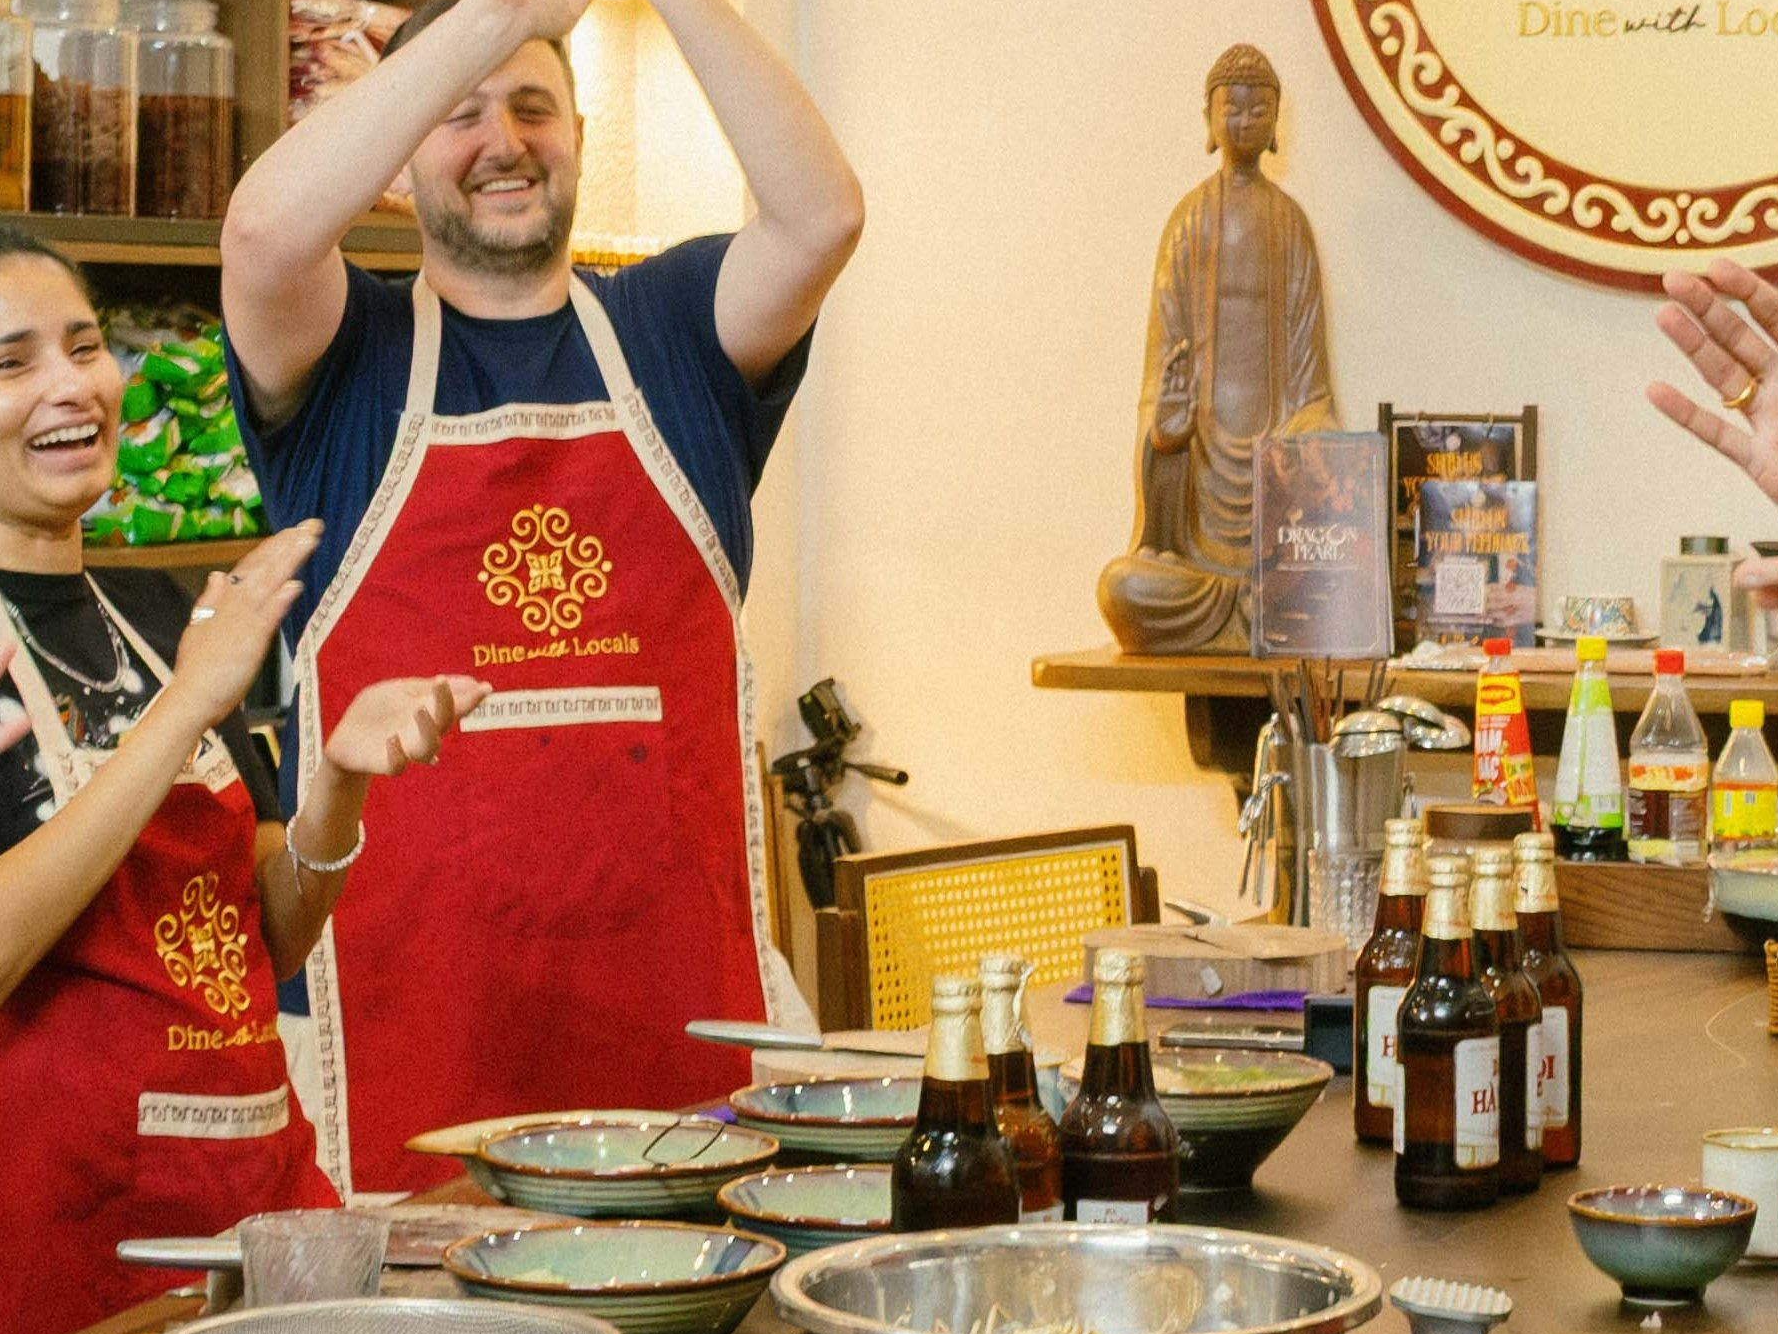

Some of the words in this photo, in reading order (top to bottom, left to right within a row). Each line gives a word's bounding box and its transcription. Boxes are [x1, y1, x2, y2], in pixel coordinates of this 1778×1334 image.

[1517, 0, 1618, 38] Dine
[1622, 4, 1707, 34] with
[1277, 522, 1359, 546] DRAGON
[473, 643, 525, 667] Dine
[572, 632, 640, 657] Locals
[167, 1024, 223, 1051] Dine
